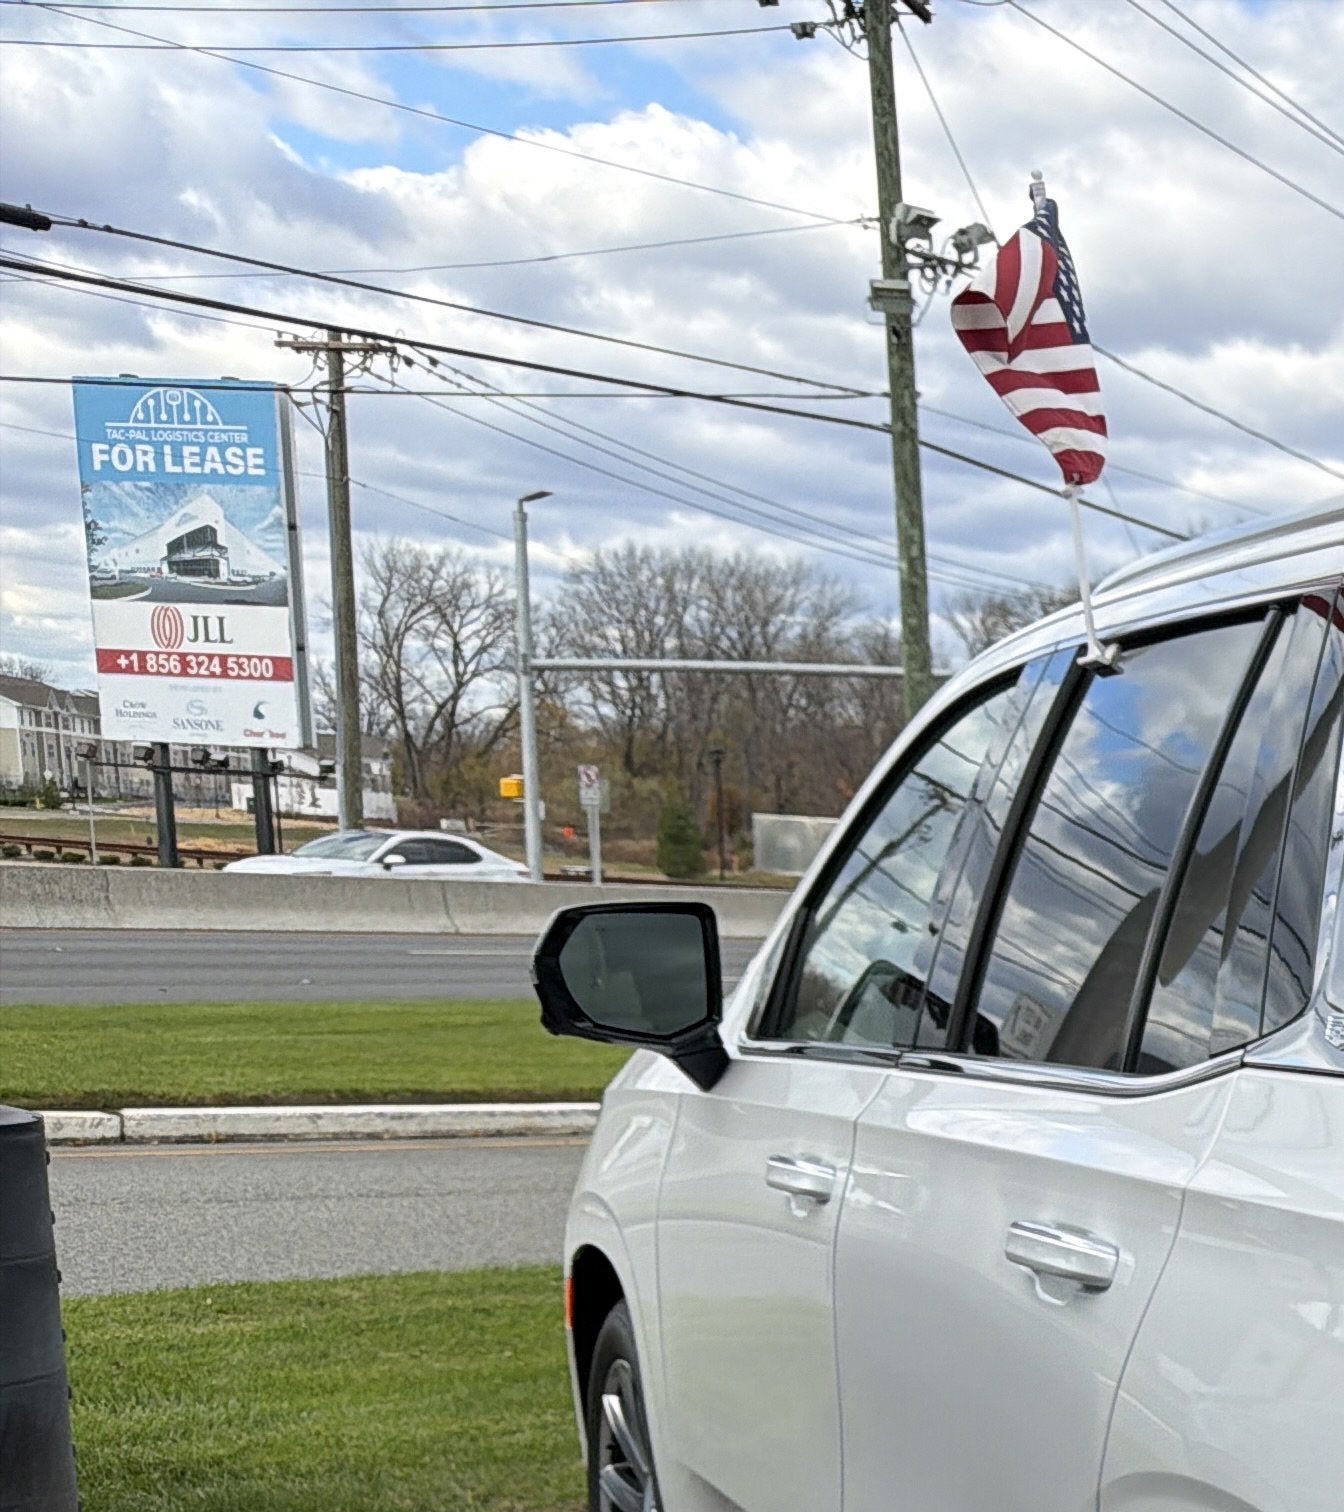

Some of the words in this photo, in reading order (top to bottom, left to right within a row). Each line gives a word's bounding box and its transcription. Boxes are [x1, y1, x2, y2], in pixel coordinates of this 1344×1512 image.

[106, 429, 149, 441] TAC-PAL
[151, 430, 205, 443] LOGISTICS
[207, 432, 248, 443] CENTER
[91, 443, 157, 472] FOR
[163, 445, 266, 476] LEASE
[187, 615, 234, 644] JLL
[117, 654, 140, 673] +1
[146, 653, 181, 674] 856
[186, 655, 222, 676] 324
[227, 658, 273, 677] 5300
